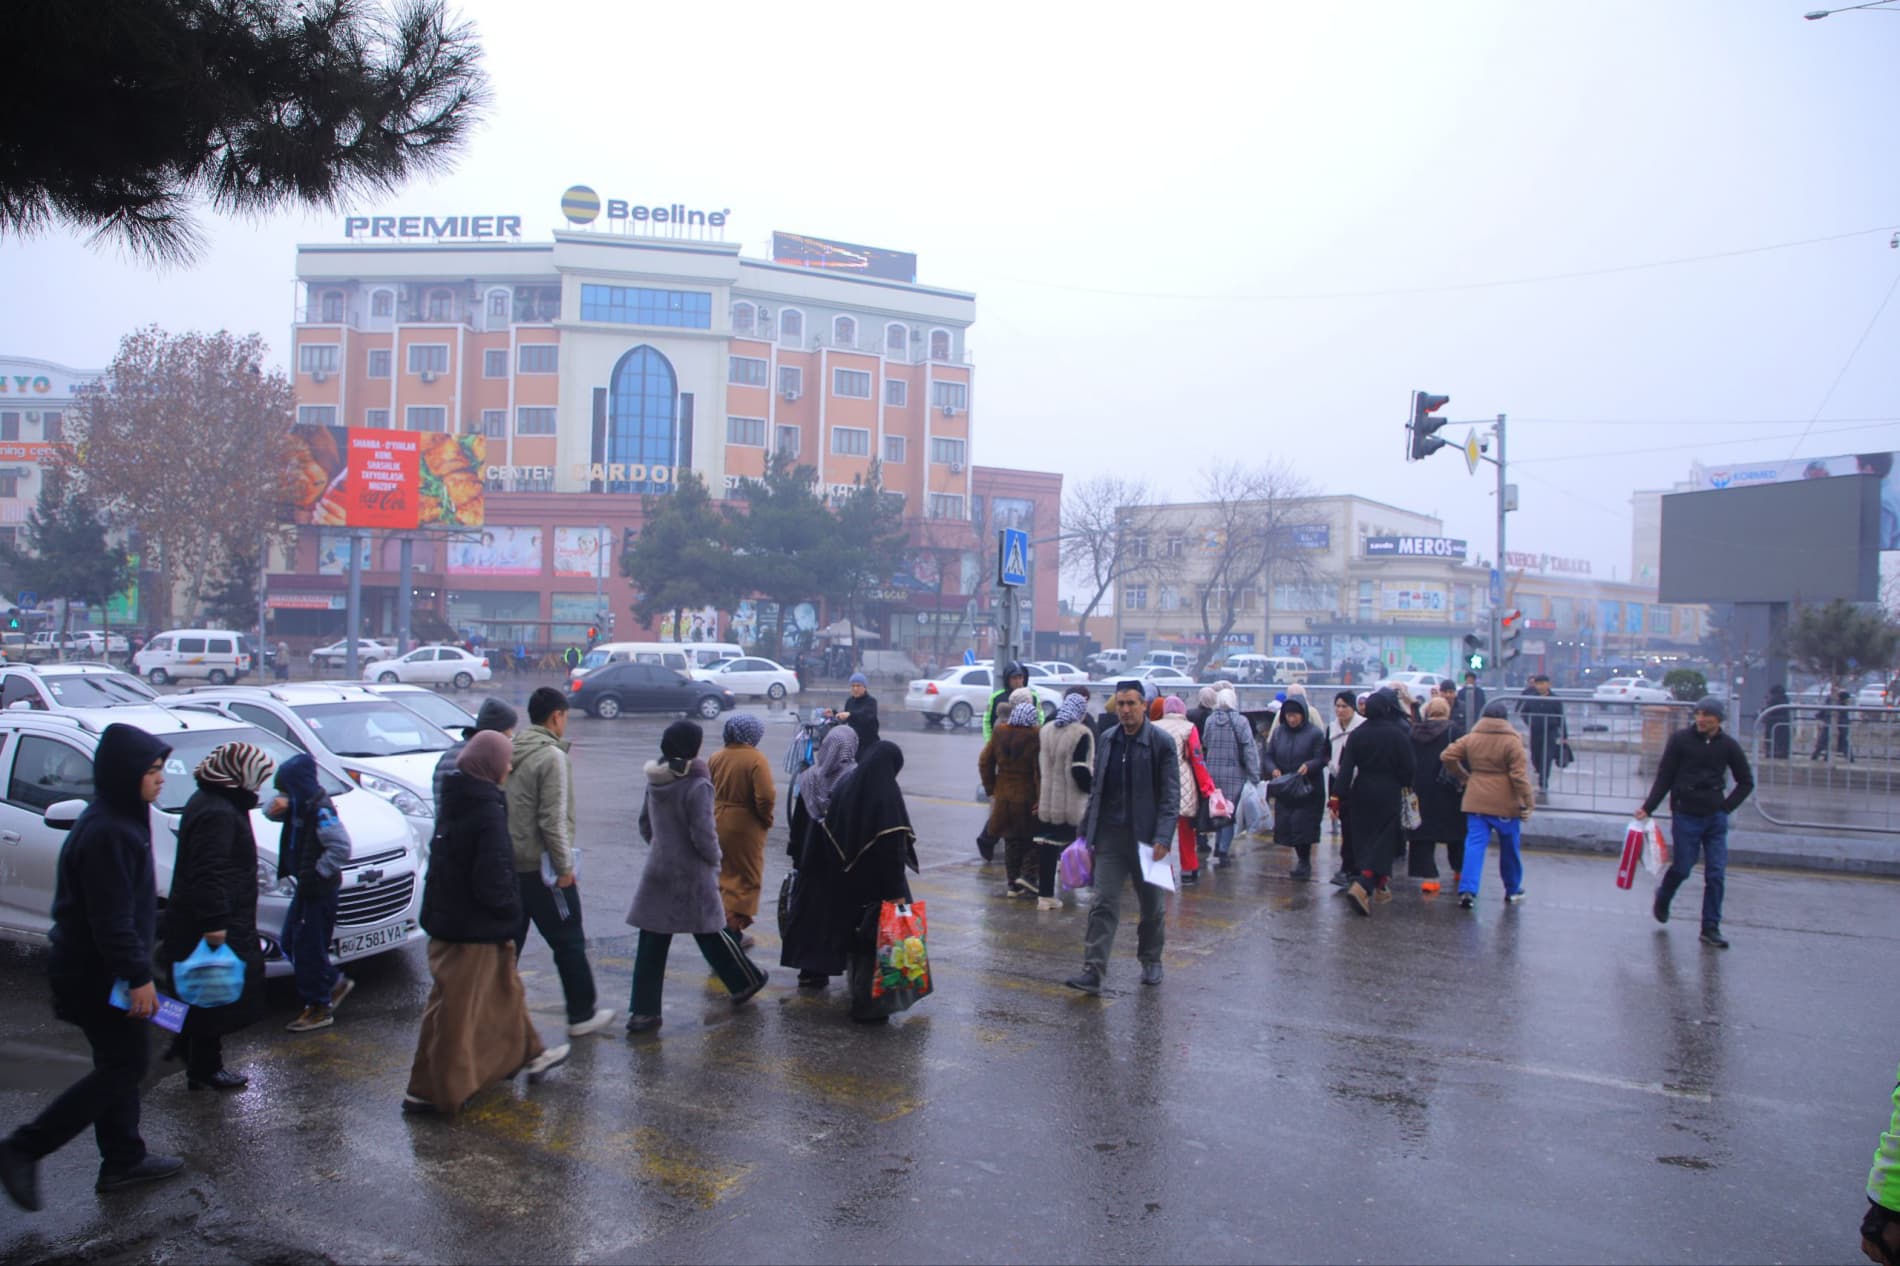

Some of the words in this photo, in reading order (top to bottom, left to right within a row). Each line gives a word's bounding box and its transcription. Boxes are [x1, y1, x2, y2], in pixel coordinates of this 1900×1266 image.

[607, 198, 728, 228] Beeline
[345, 216, 521, 238] PREMIER
[1398, 537, 1453, 556] MEROS
